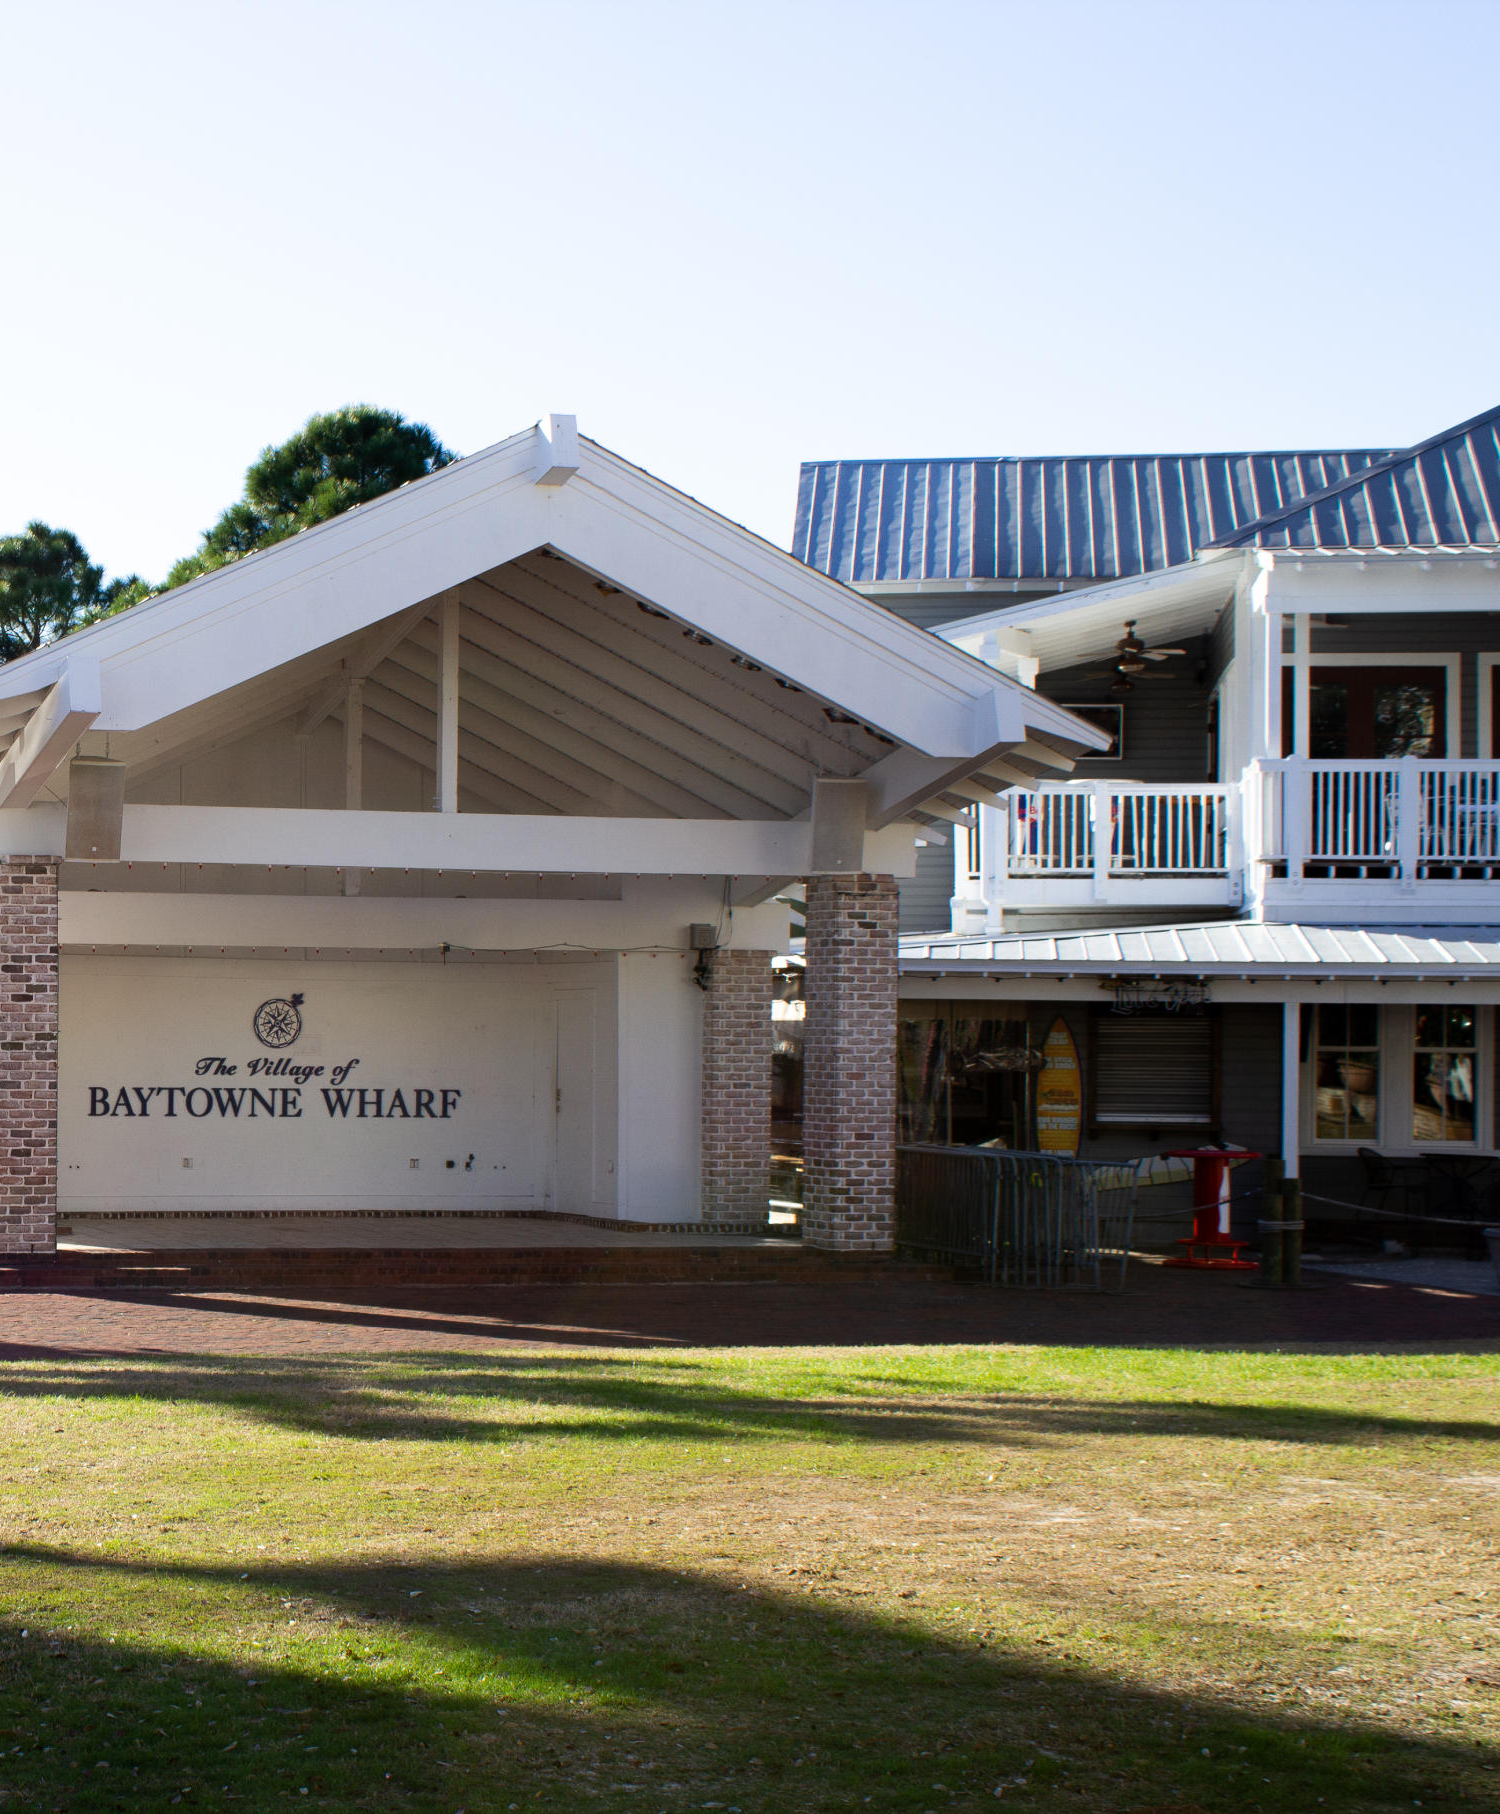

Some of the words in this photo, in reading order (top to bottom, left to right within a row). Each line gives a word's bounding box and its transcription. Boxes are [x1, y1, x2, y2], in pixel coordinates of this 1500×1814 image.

[194, 1056, 237, 1077] The
[247, 1057, 325, 1085] Village
[330, 1058, 361, 1085] of
[87, 1086, 303, 1118] BAYTOWNE
[321, 1088, 462, 1118] WHARF
